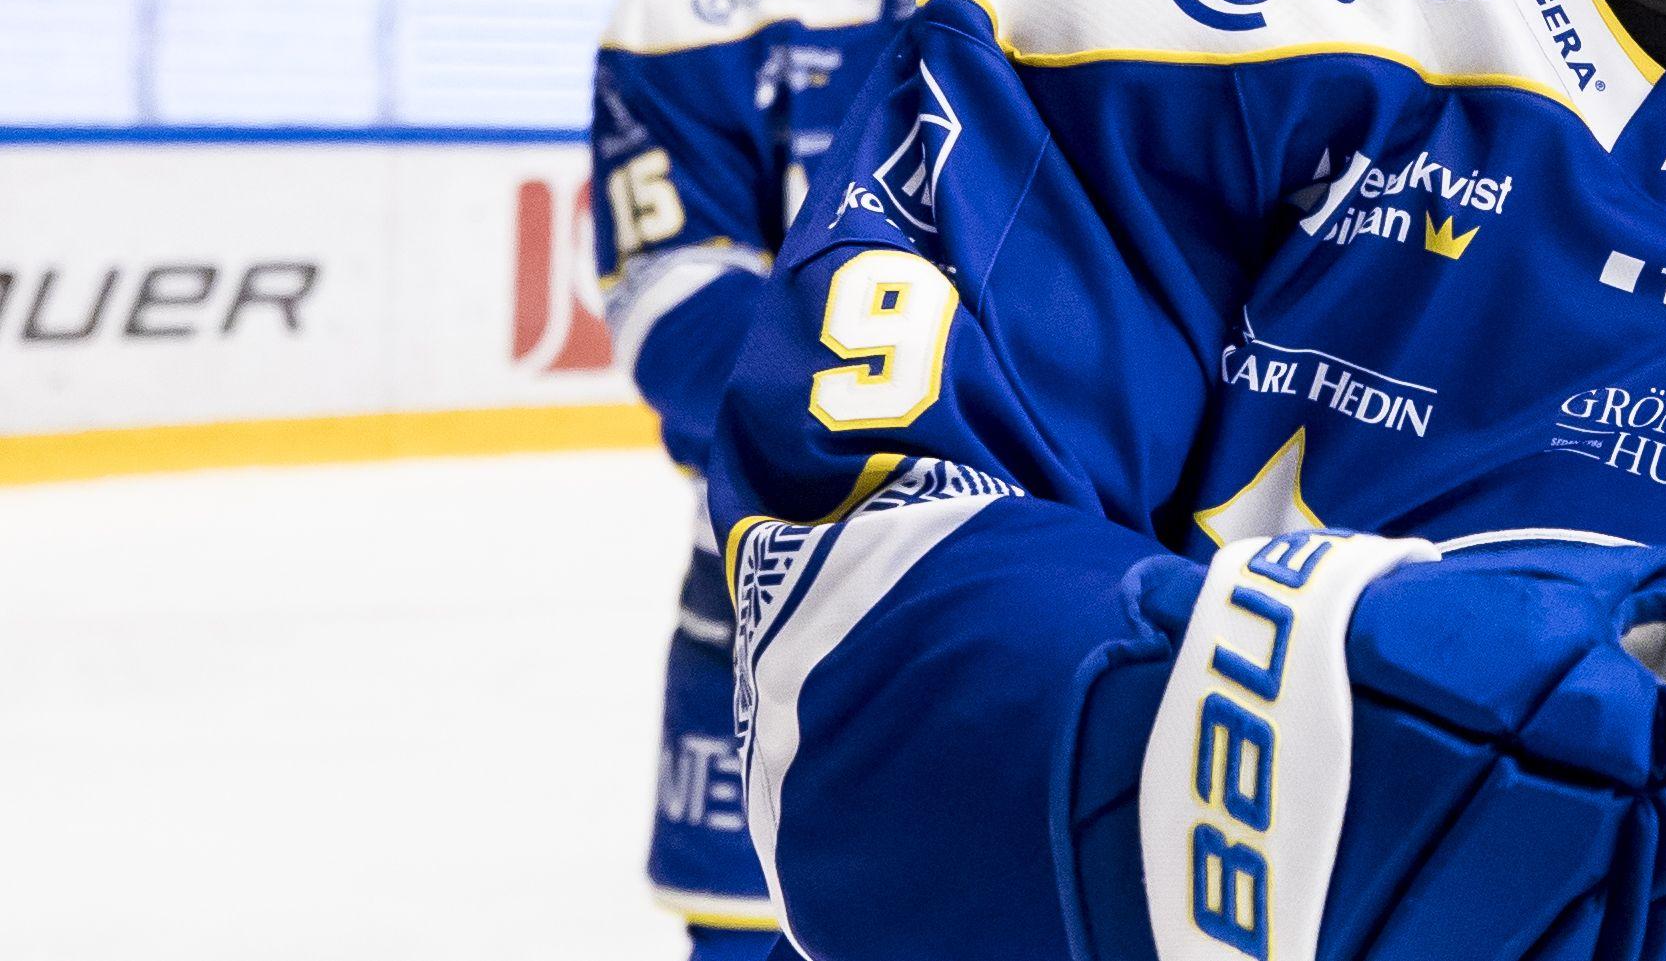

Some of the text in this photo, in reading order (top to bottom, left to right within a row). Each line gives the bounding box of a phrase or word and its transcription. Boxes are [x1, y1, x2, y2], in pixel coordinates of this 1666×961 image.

[608, 148, 685, 256] 15
[0, 259, 320, 341] UER
[808, 249, 960, 431] 9
[1308, 361, 1434, 438] HEDIN
[1192, 529, 1356, 961] BAUE
